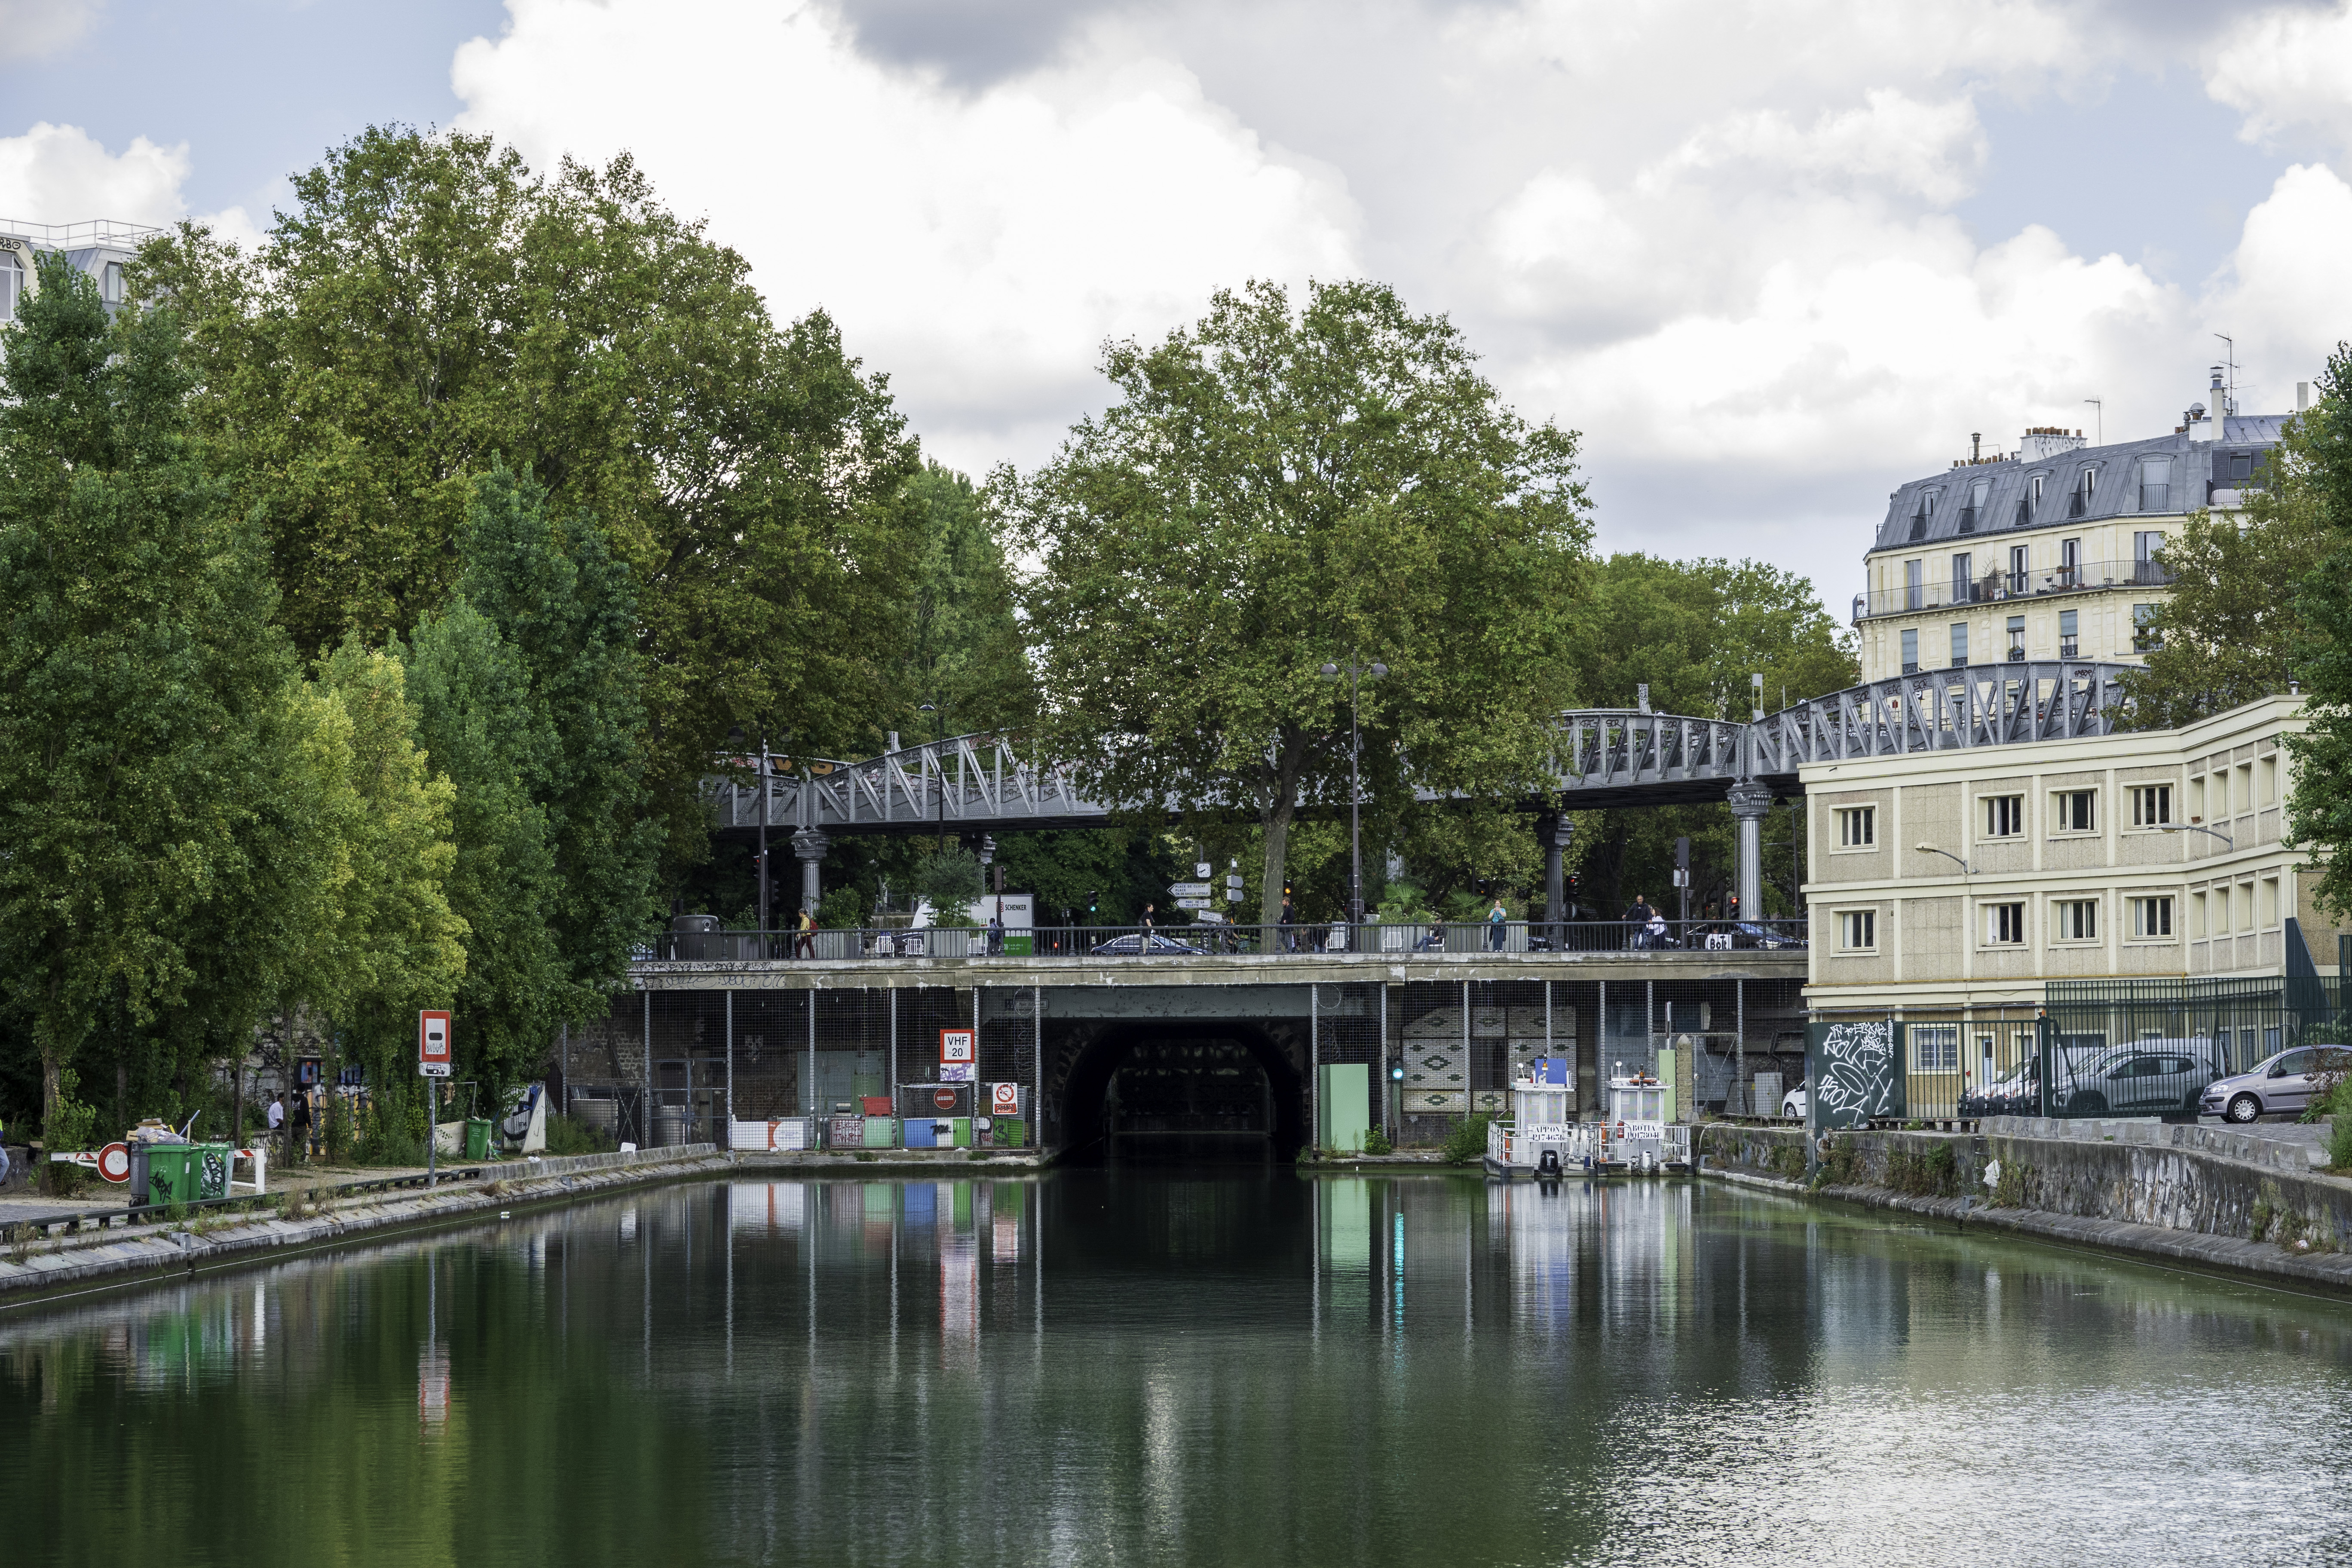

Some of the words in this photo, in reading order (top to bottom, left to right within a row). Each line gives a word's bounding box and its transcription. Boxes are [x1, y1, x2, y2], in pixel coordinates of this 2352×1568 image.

[1710, 938, 1727, 949] Bolt
[947, 1036, 968, 1045] VHF
[952, 1048, 963, 1057] 20
